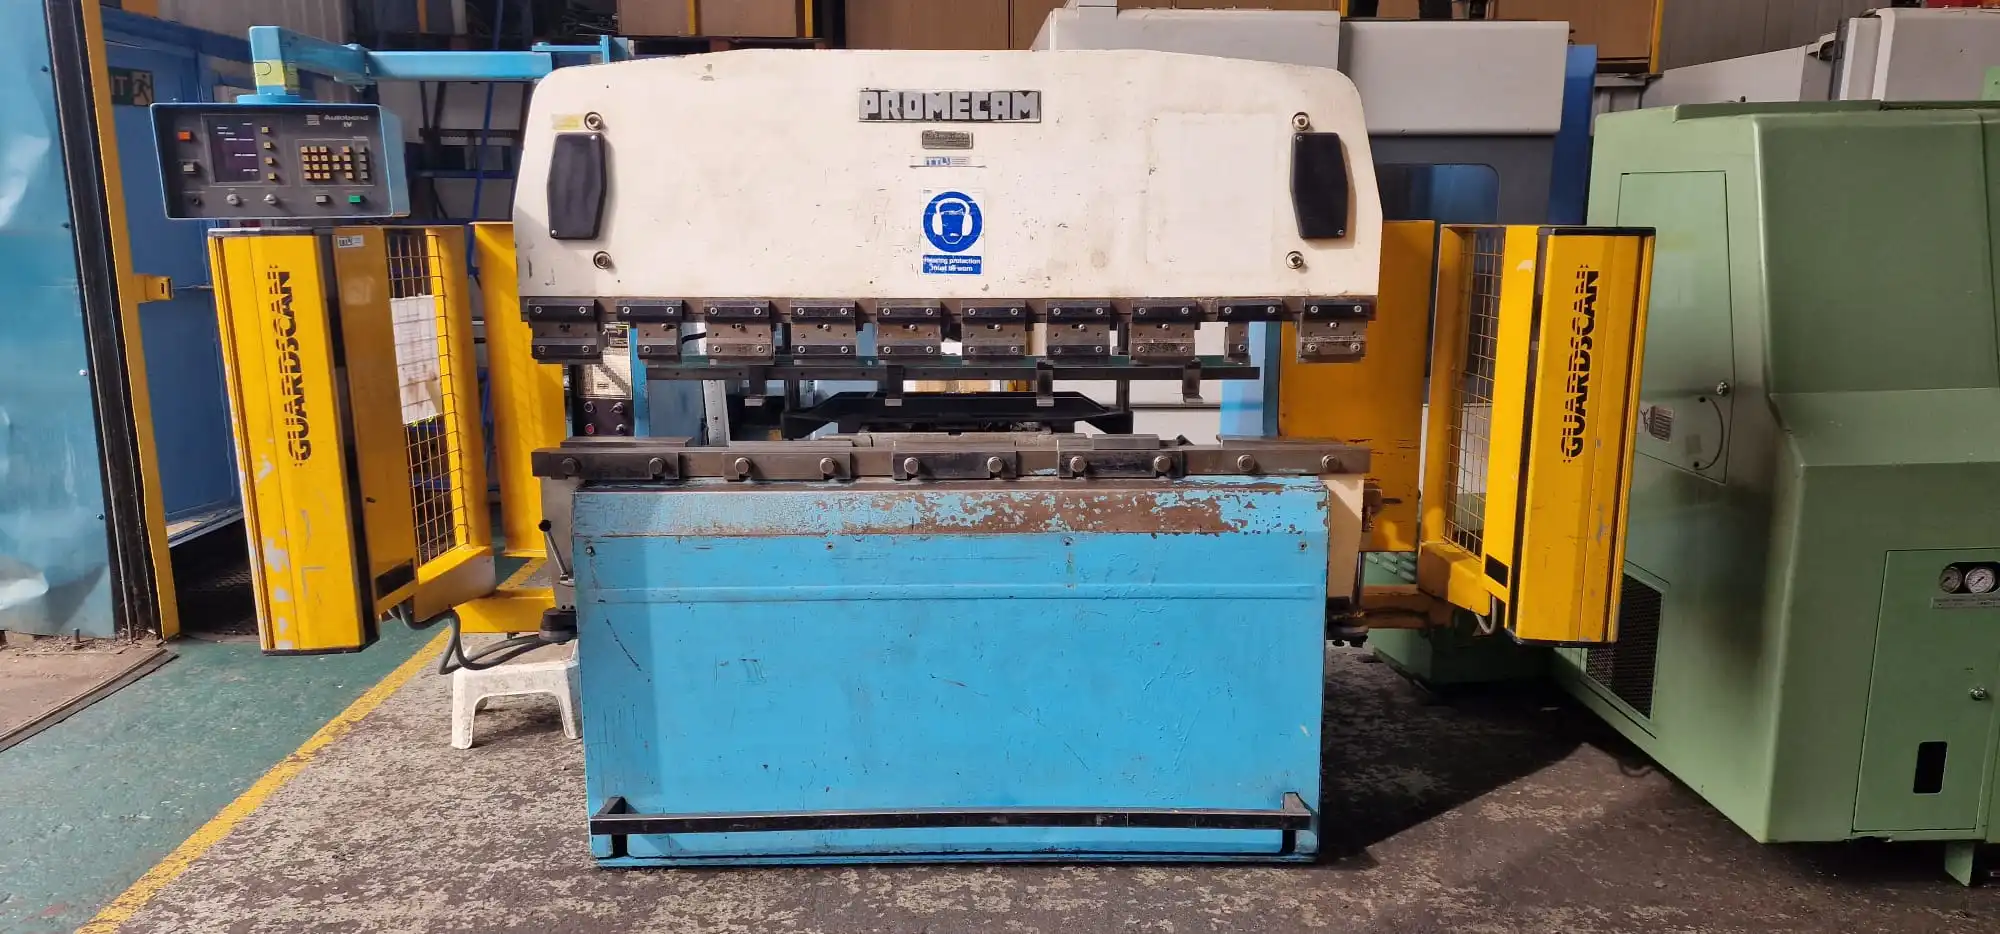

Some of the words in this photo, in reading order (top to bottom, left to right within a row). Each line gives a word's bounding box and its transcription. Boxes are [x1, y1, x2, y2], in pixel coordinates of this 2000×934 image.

[859, 91, 1039, 120] PROMECAM
[922, 257, 948, 265] Hearing
[949, 257, 981, 265] protection
[267, 268, 312, 463] GUARDSCAN
[1560, 268, 1600, 461] GUARDSCAN
